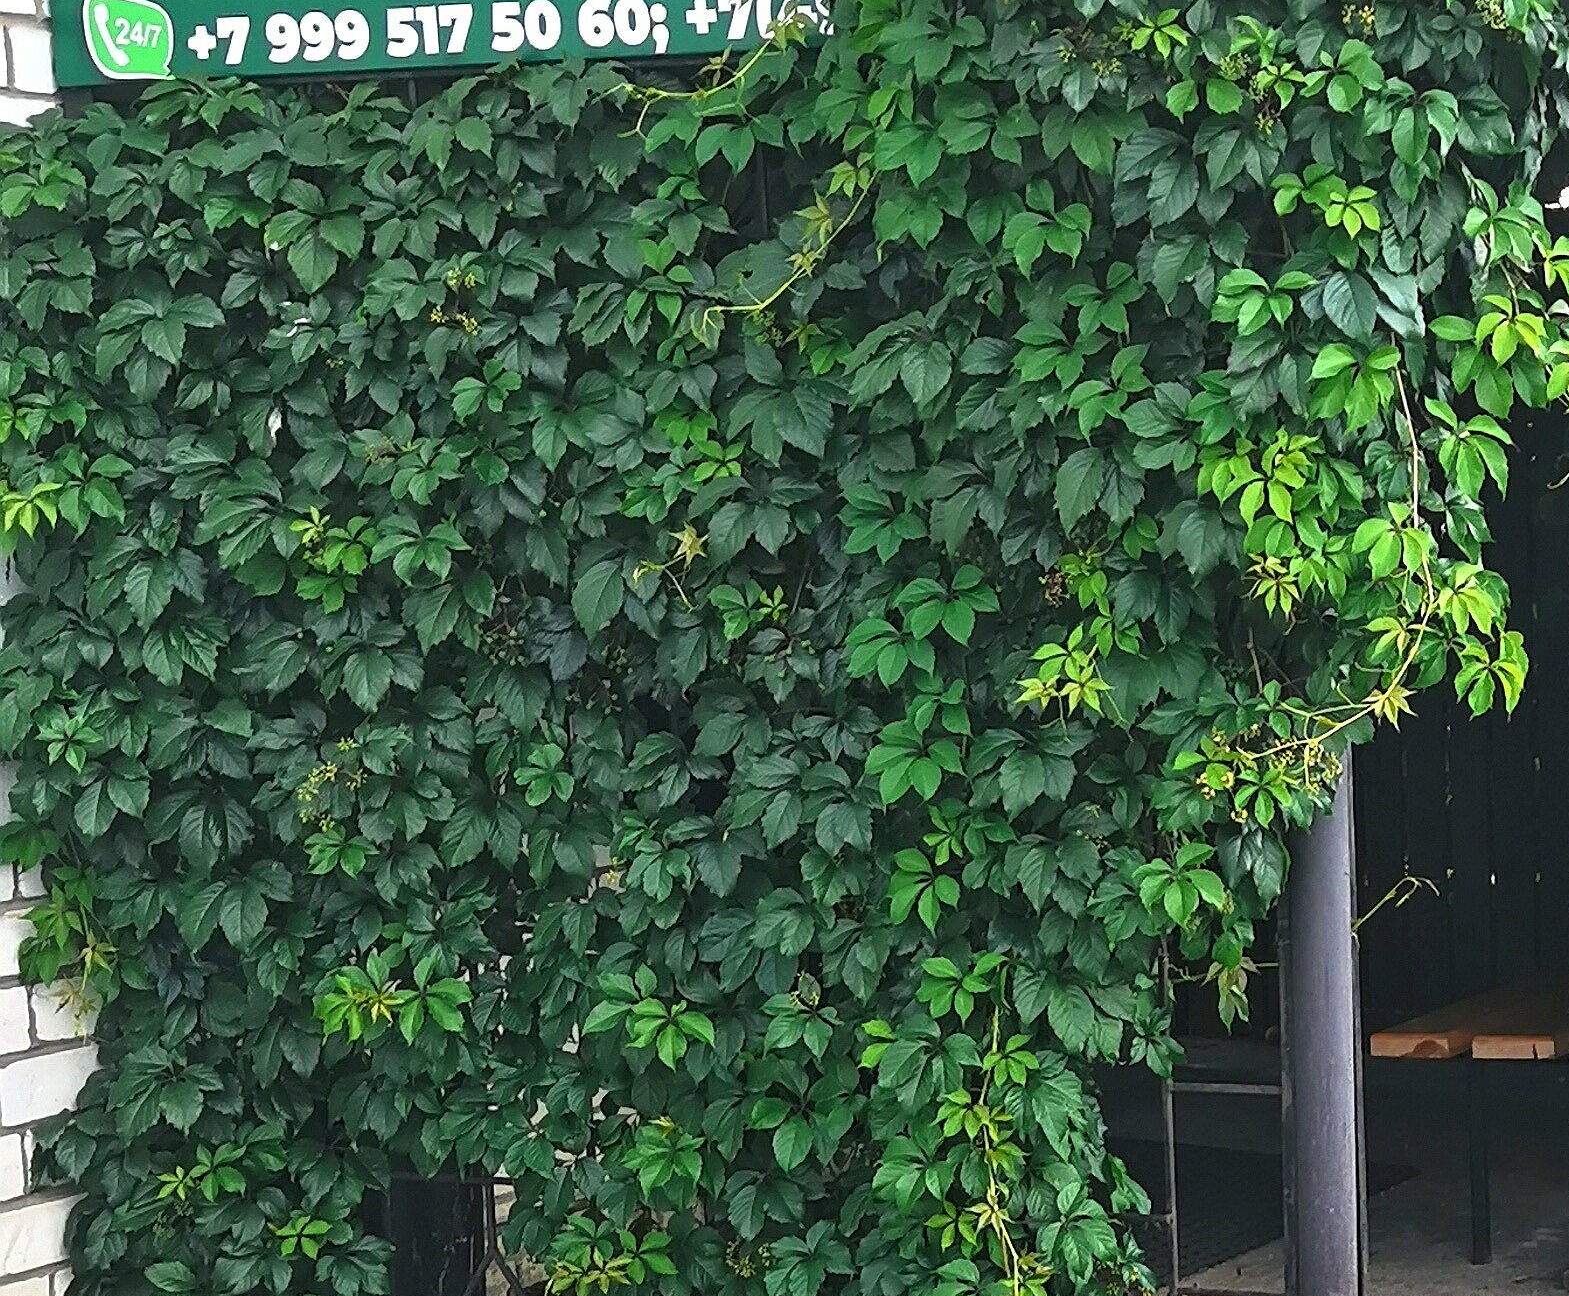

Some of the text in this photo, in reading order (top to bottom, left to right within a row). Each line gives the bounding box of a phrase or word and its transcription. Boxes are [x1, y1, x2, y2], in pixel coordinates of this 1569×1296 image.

[114, 17, 162, 49] 24/7
[187, 15, 251, 65] +7
[265, 9, 370, 64] 999
[386, 3, 474, 58] 517
